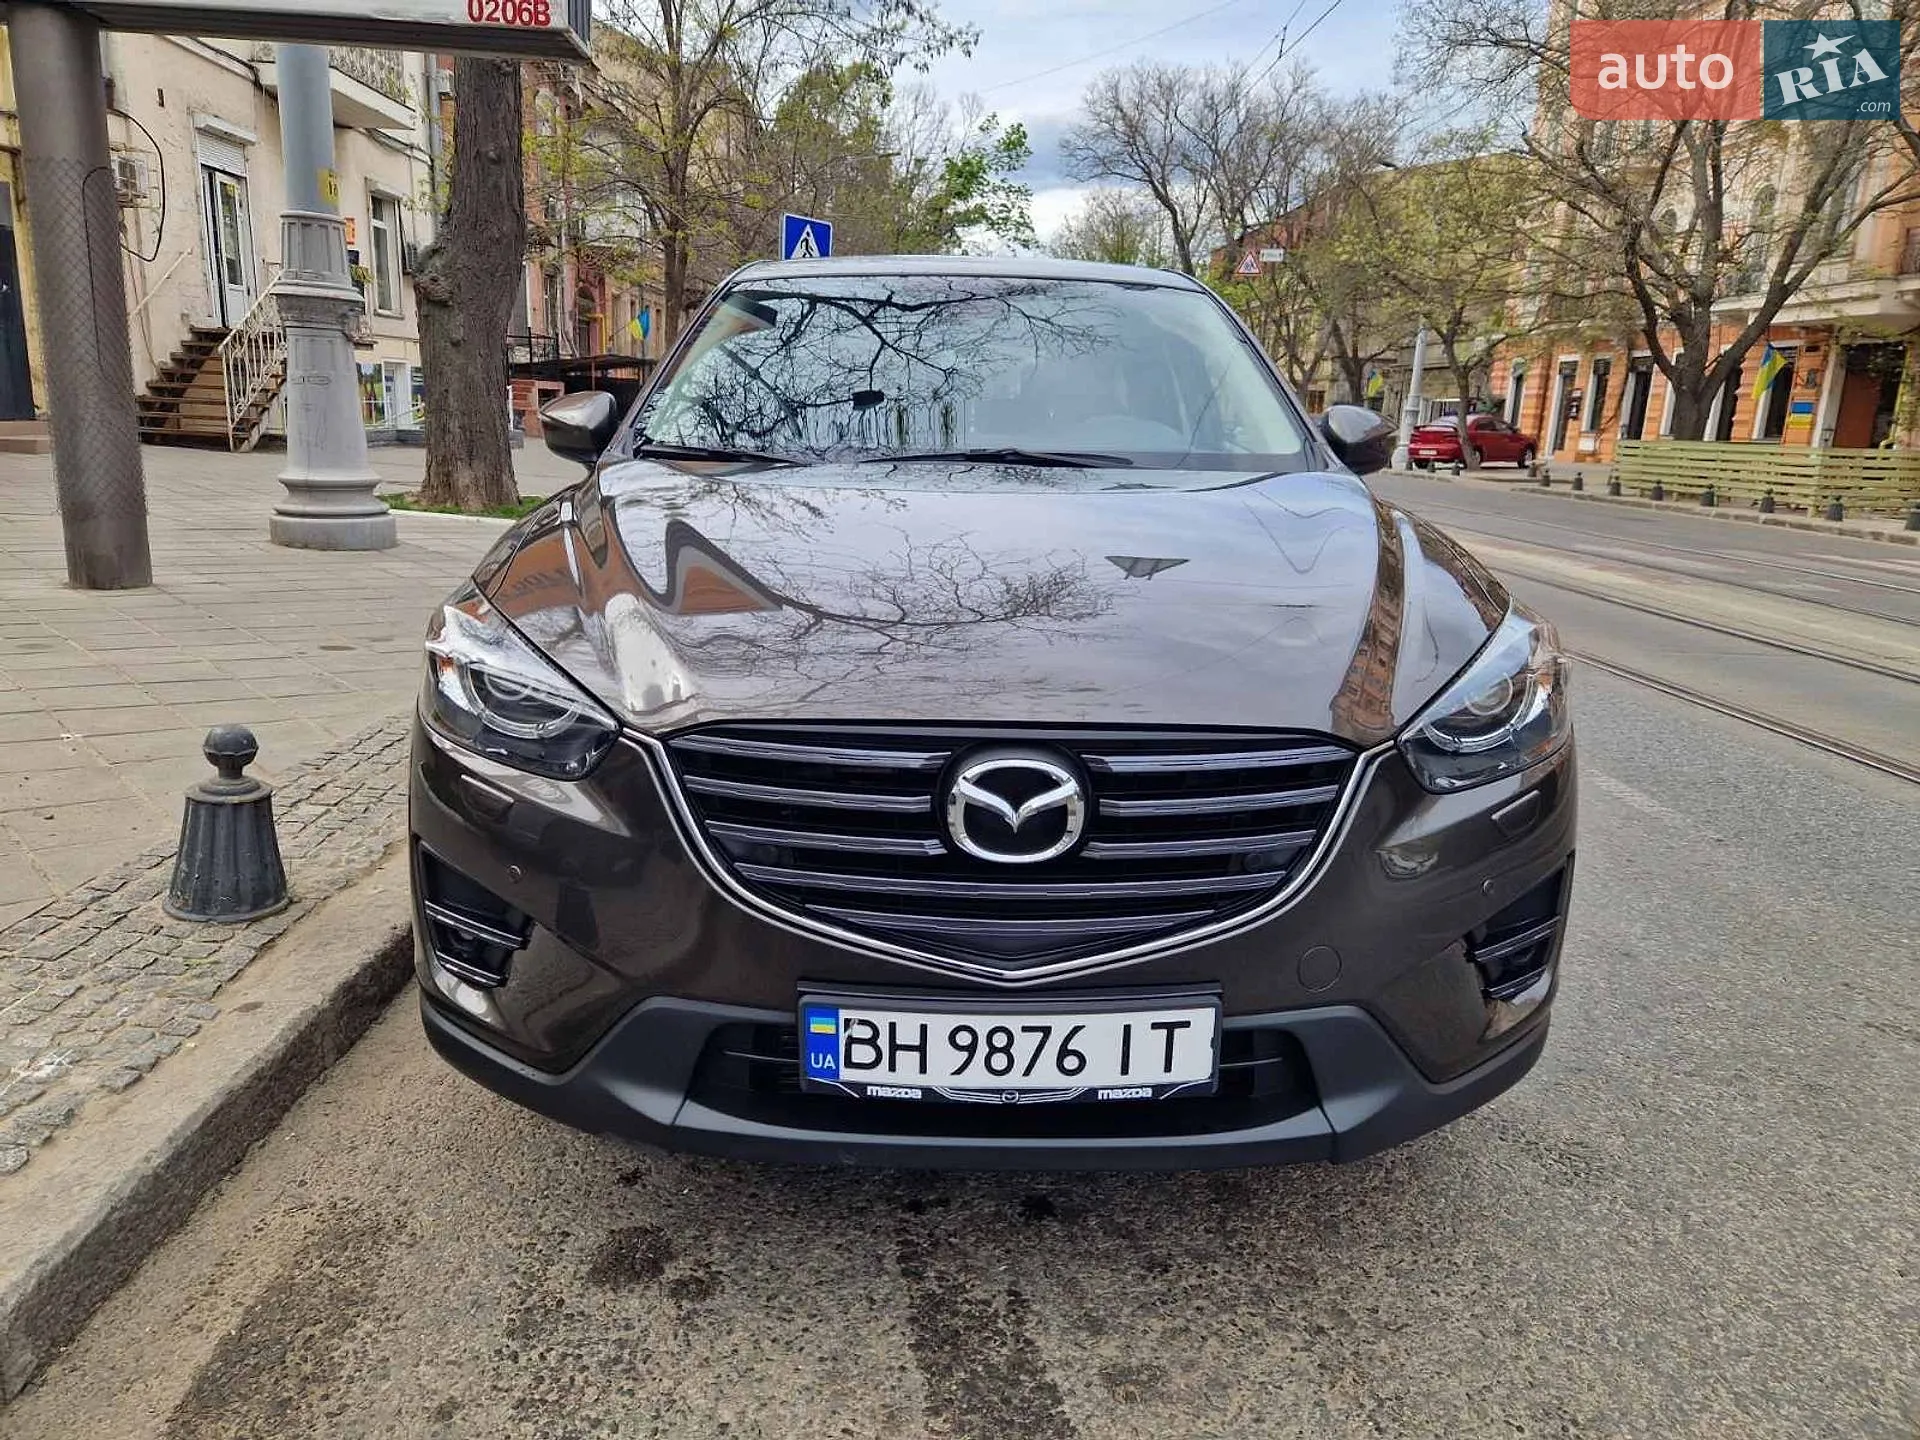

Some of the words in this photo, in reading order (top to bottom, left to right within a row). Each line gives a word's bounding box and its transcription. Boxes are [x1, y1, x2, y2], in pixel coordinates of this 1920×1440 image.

[843, 1017, 928, 1075] BH
[948, 1024, 1087, 1078] 9876
[1119, 1020, 1191, 1076] IT
[810, 1052, 837, 1070] UA
[866, 1085, 922, 1100] mazda
[1098, 1086, 1152, 1100] mazda
